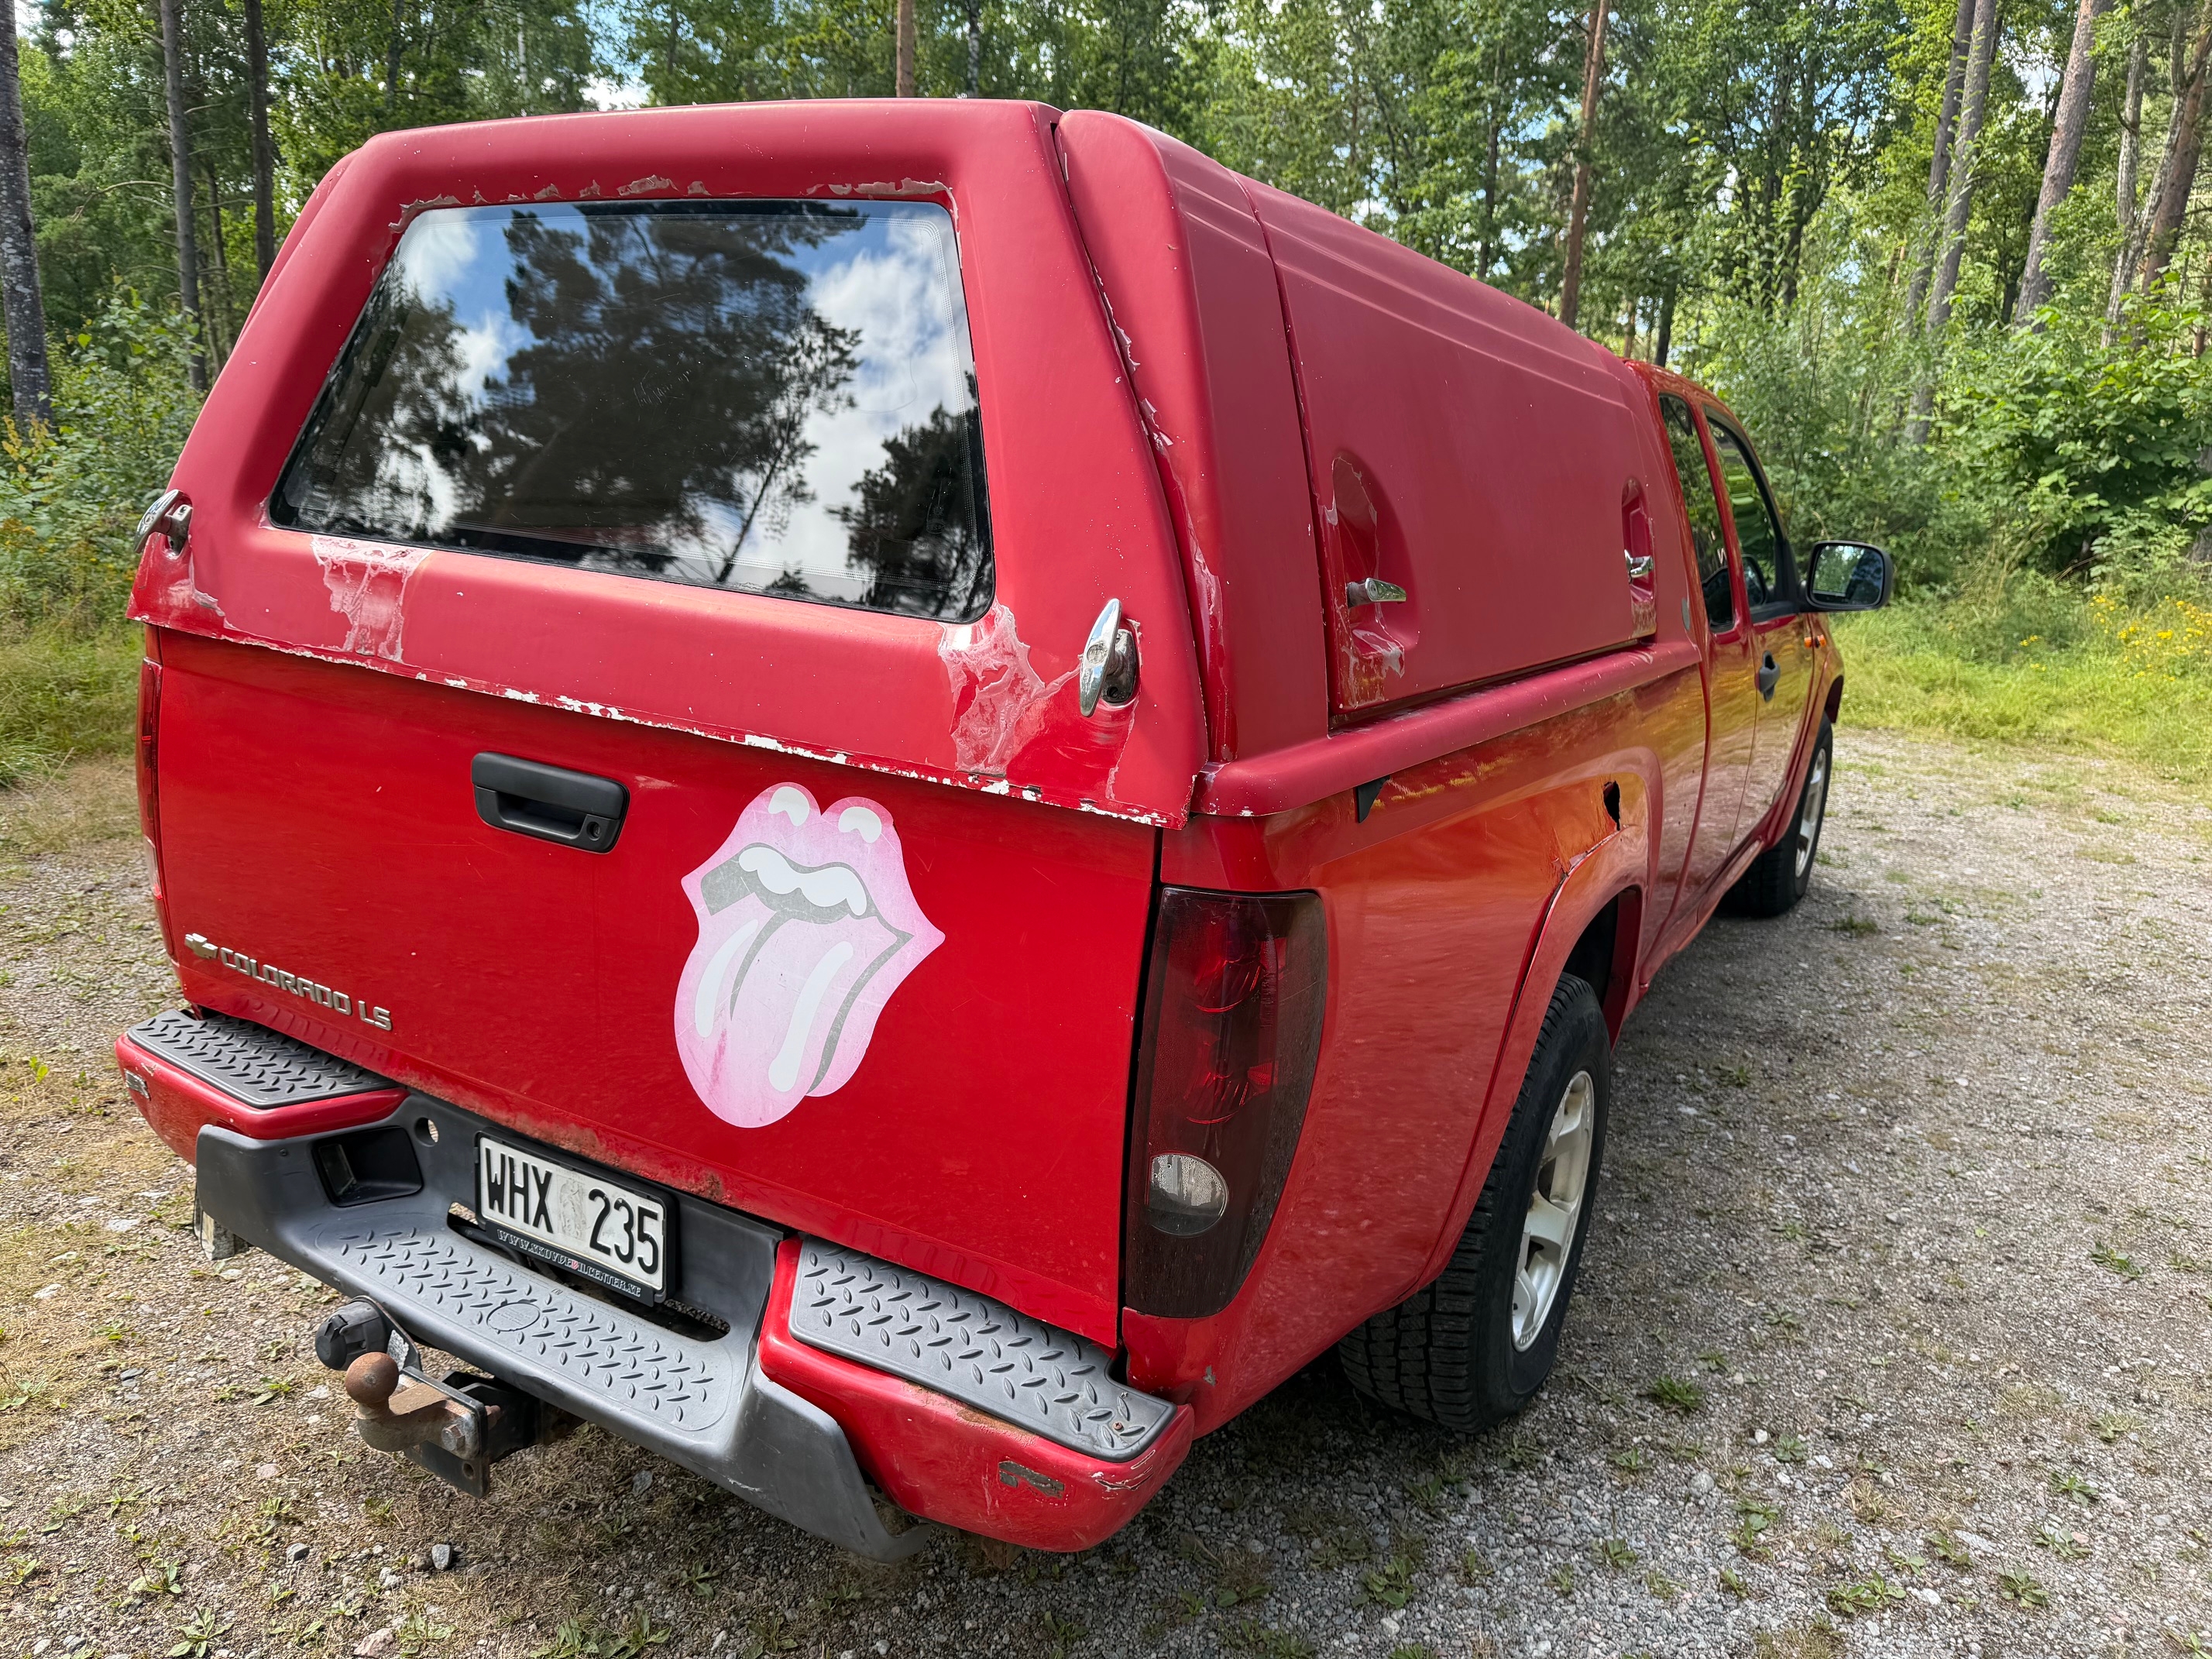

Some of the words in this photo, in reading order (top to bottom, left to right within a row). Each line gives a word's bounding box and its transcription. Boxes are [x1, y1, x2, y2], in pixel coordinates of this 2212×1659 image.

[221, 946, 352, 1015] COLORADO
[358, 1000, 392, 1031] LS
[485, 1147, 554, 1234] WHX
[589, 1188, 658, 1275] 235
